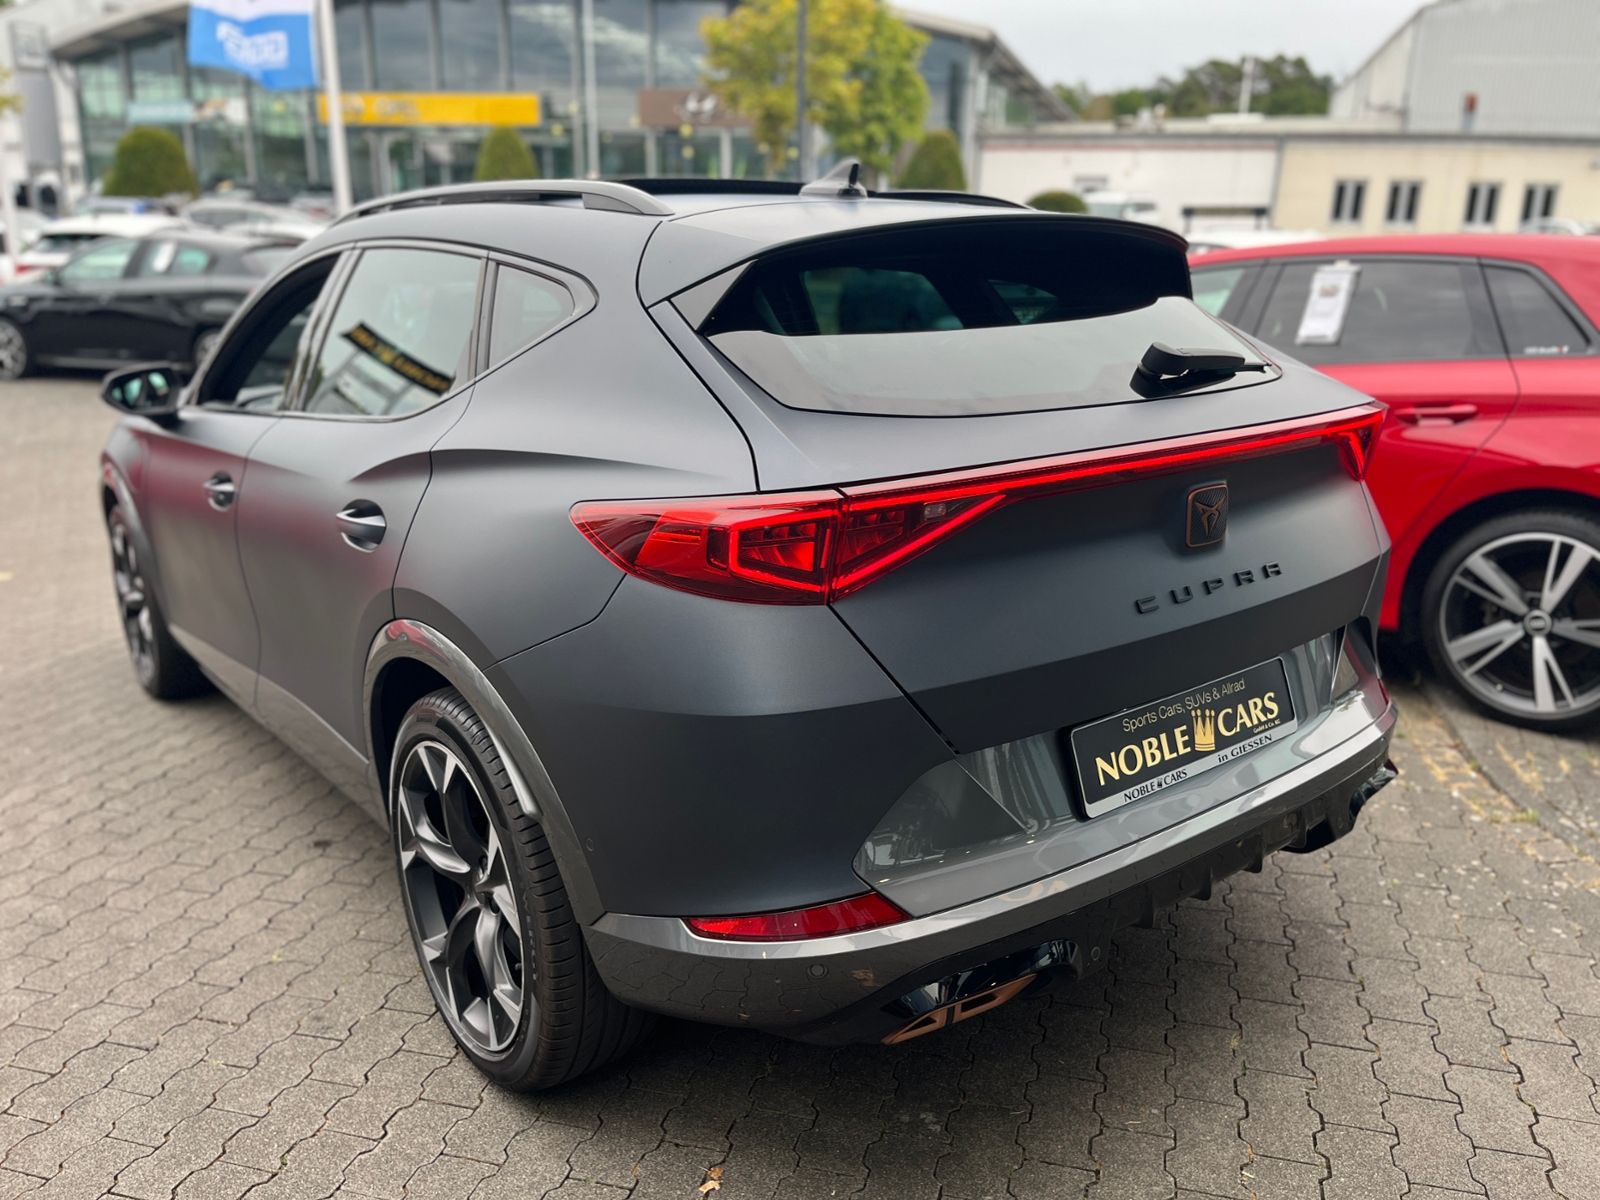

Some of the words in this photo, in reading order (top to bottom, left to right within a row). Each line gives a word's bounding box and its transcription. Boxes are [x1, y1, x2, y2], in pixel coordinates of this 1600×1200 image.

[1134, 561, 1282, 614] CUPRA
[1123, 711, 1157, 733] Sports
[1159, 704, 1185, 719] Cars,
[1185, 691, 1211, 709] SUVs
[1212, 688, 1221, 700] &
[1221, 678, 1245, 697] Allrad
[1095, 725, 1190, 786] NOBLE
[1218, 692, 1279, 736] CARS
[1217, 753, 1229, 764] in
[1230, 734, 1272, 758] GIESSEN
[1124, 782, 1156, 802] NOBLE
[1163, 769, 1188, 786] CARS
